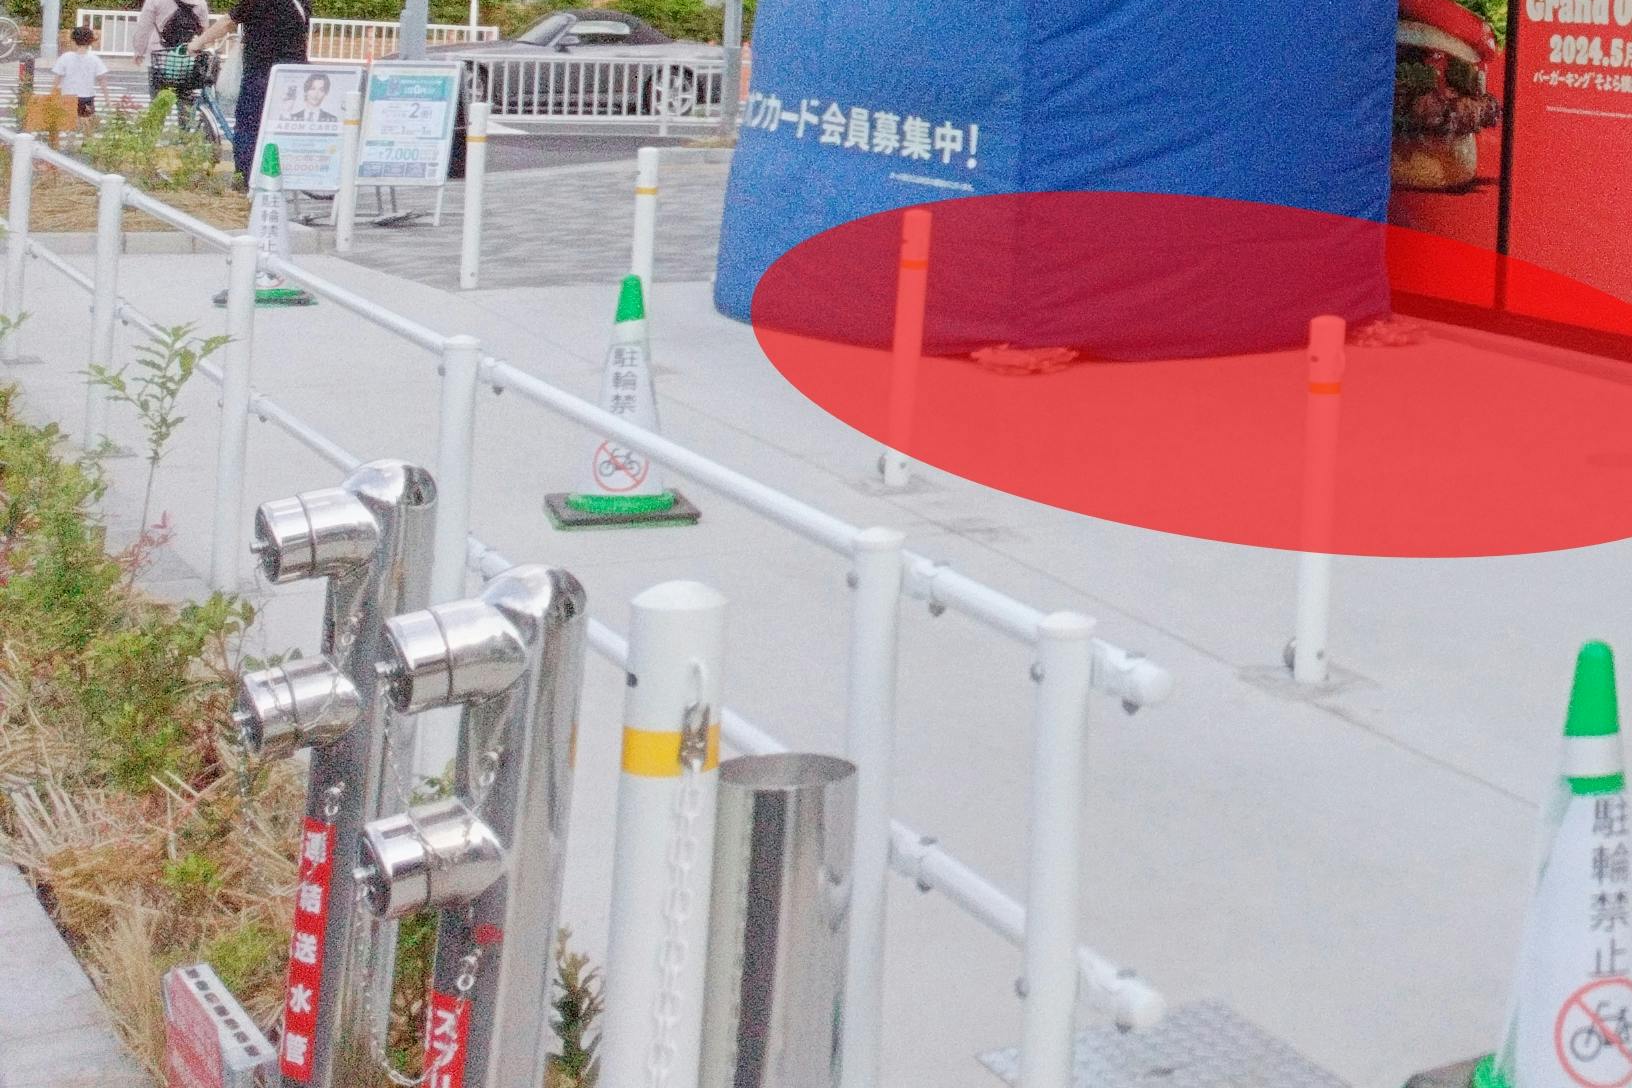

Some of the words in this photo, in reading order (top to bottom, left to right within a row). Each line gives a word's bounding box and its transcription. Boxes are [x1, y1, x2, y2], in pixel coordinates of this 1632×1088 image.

[611, 348, 638, 414] 駐輪禁
[1589, 796, 1630, 978] 駐輪禁止
